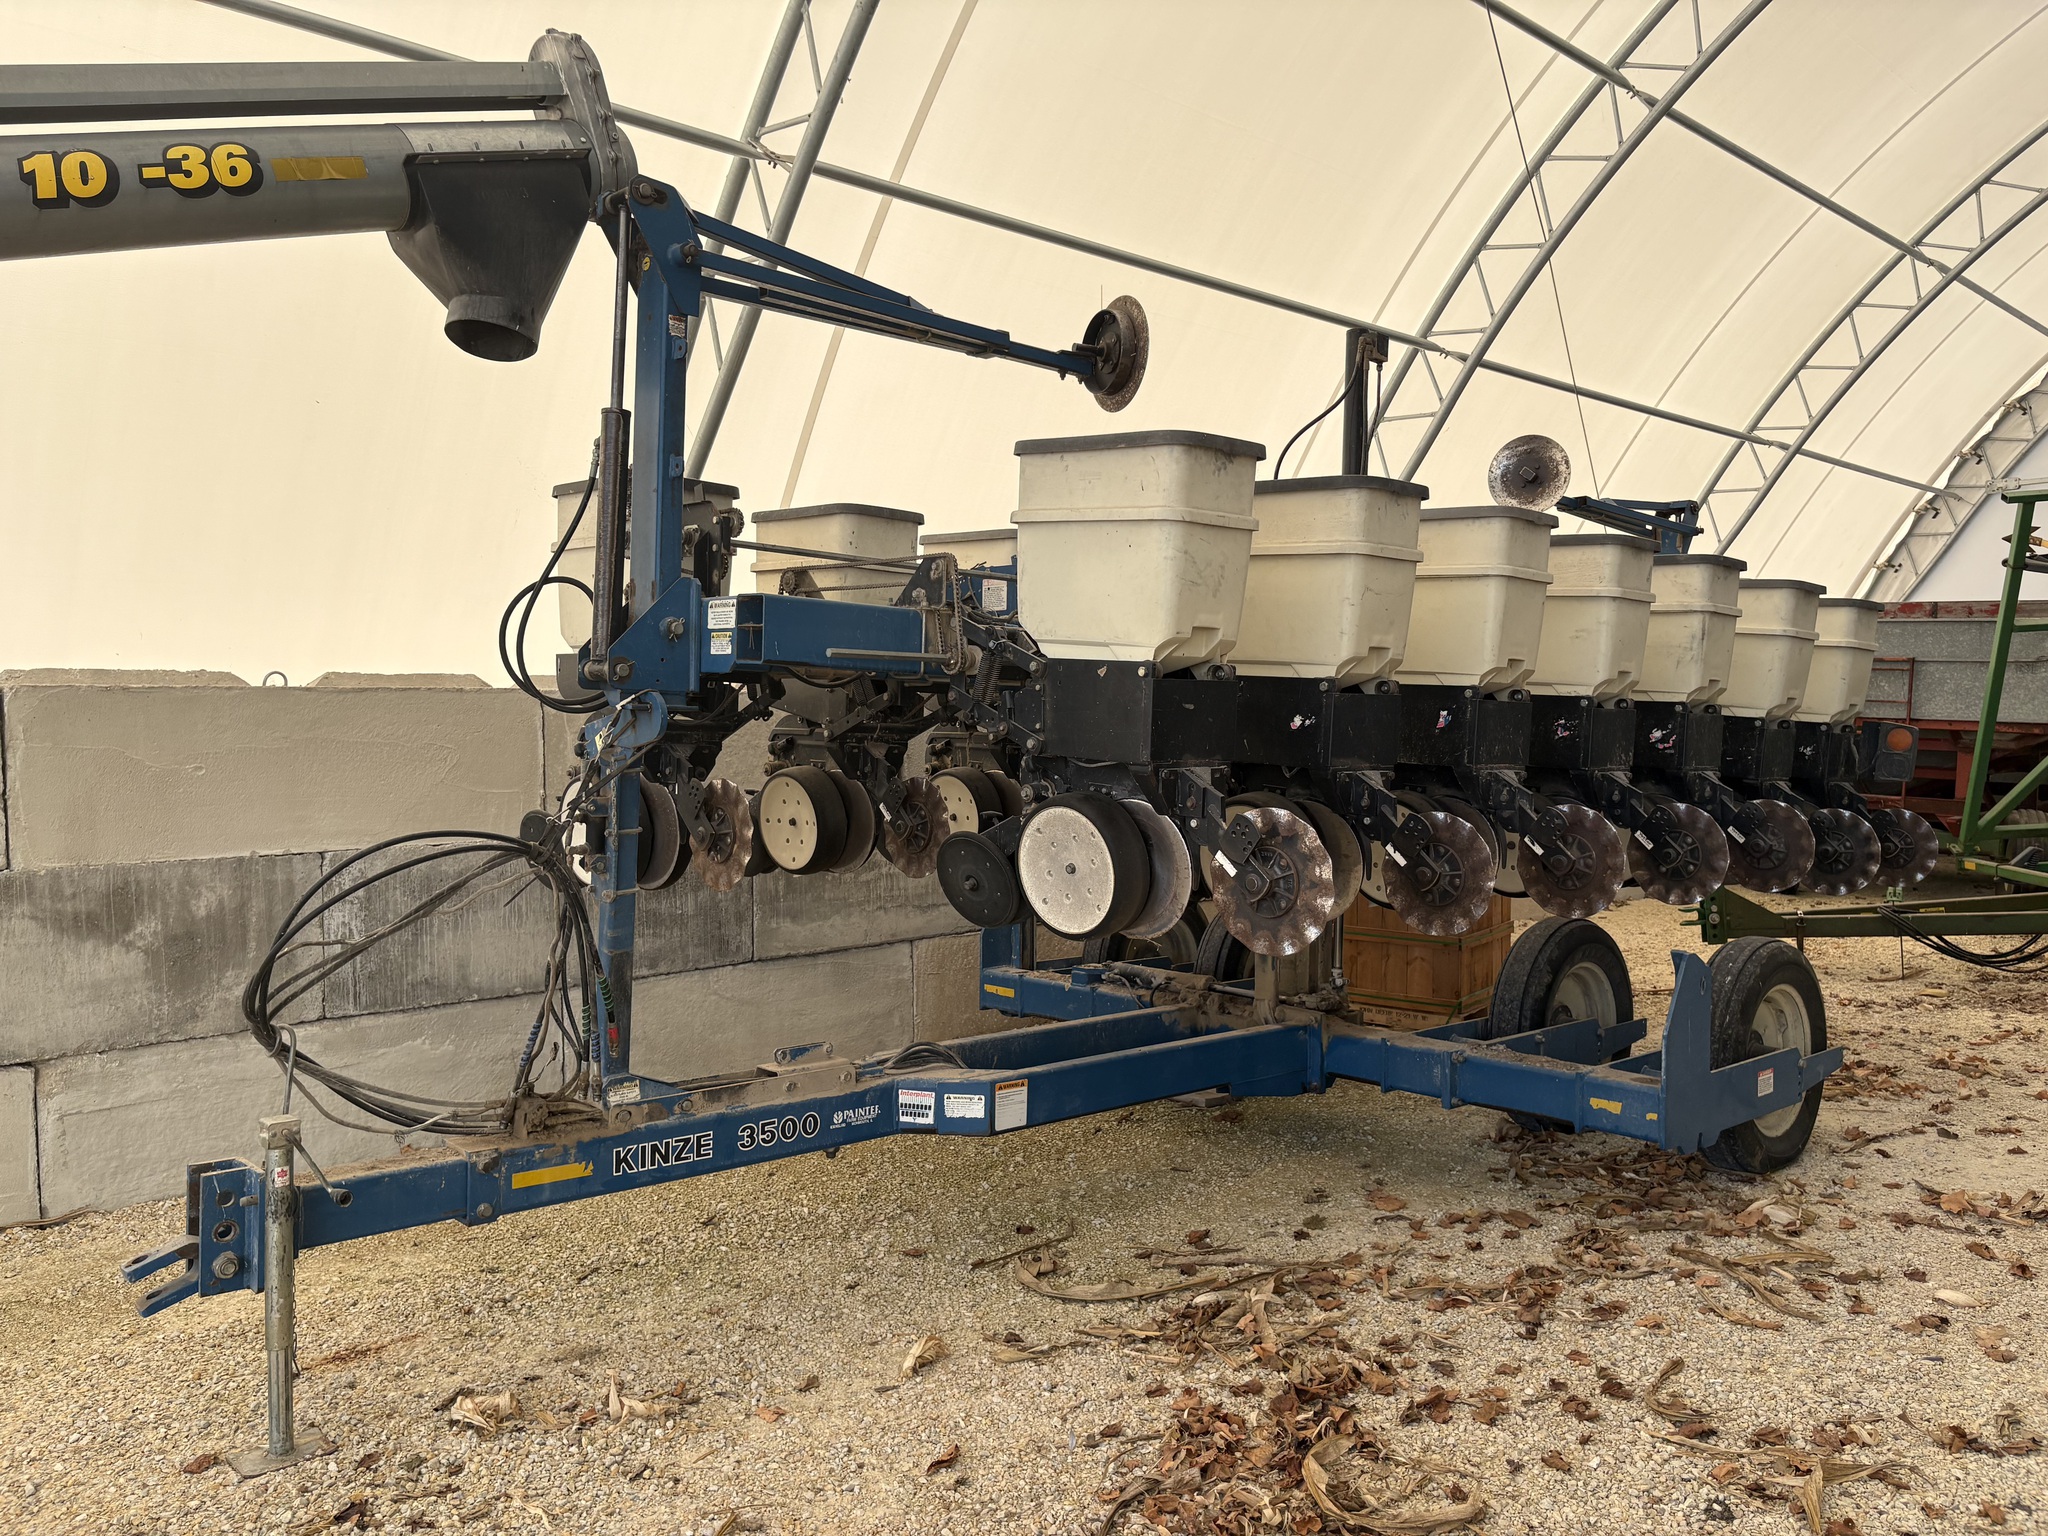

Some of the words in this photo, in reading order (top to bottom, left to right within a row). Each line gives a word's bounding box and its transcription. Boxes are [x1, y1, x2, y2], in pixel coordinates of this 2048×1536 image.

[19, 149, 112, 204] 10
[613, 1131, 714, 1176] KINZE
[737, 1112, 821, 1151] 3500
